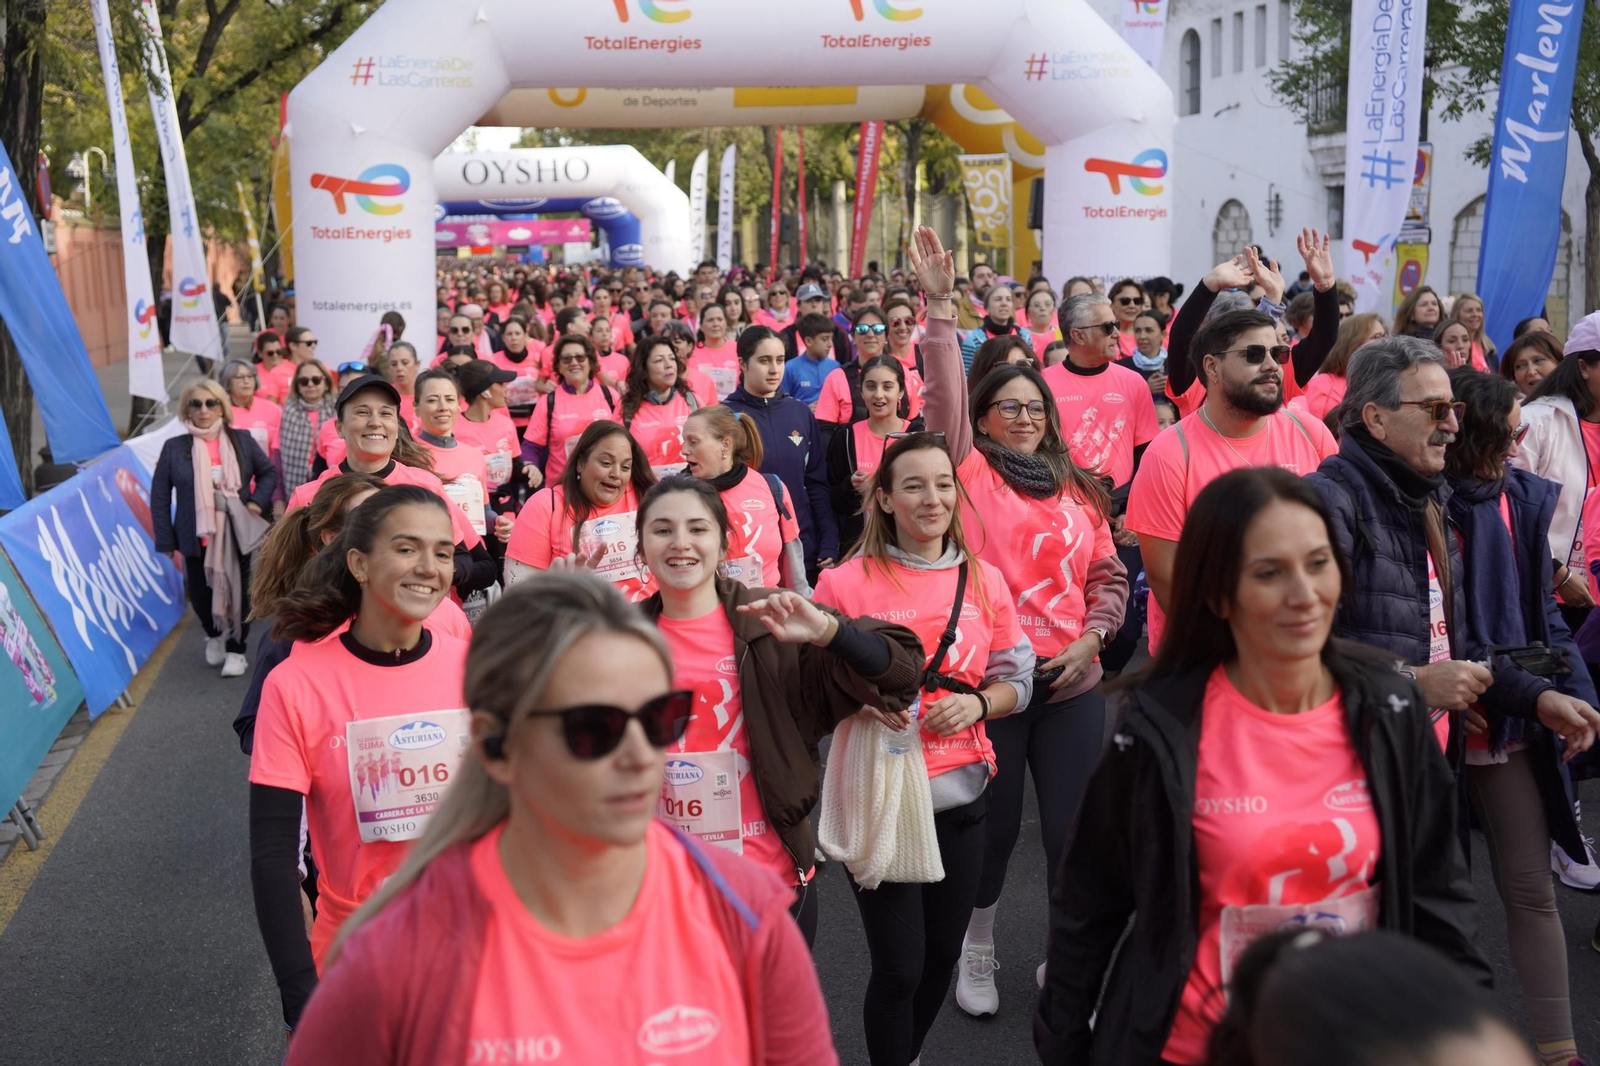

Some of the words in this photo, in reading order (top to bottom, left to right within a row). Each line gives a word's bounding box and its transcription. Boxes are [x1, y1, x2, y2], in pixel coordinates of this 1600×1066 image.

[584, 36, 702, 53] TotalEnergies
[821, 34, 931, 50] TotalEnergies
[1501, 0, 1574, 184] Marlen
[623, 96, 639, 106] de
[642, 96, 698, 107] Deportes
[462, 156, 590, 187] OYSHO
[1083, 206, 1168, 221] TotalEnergies
[311, 226, 412, 243] TotalEnergies
[312, 301, 412, 313] totalenergies.es
[1034, 616, 1046, 627] DE
[1035, 628, 1051, 637] 2025
[358, 740, 386, 751] SUMA
[393, 732, 443, 746] ASTURIANA
[399, 763, 449, 787] 016
[414, 792, 439, 804] 3630
[1194, 795, 1268, 816] OYSHO
[375, 808, 404, 819] CARRERA
[406, 806, 415, 815] DE
[416, 805, 425, 813] LA
[665, 798, 703, 817] 016
[373, 821, 416, 836] OYSHO
